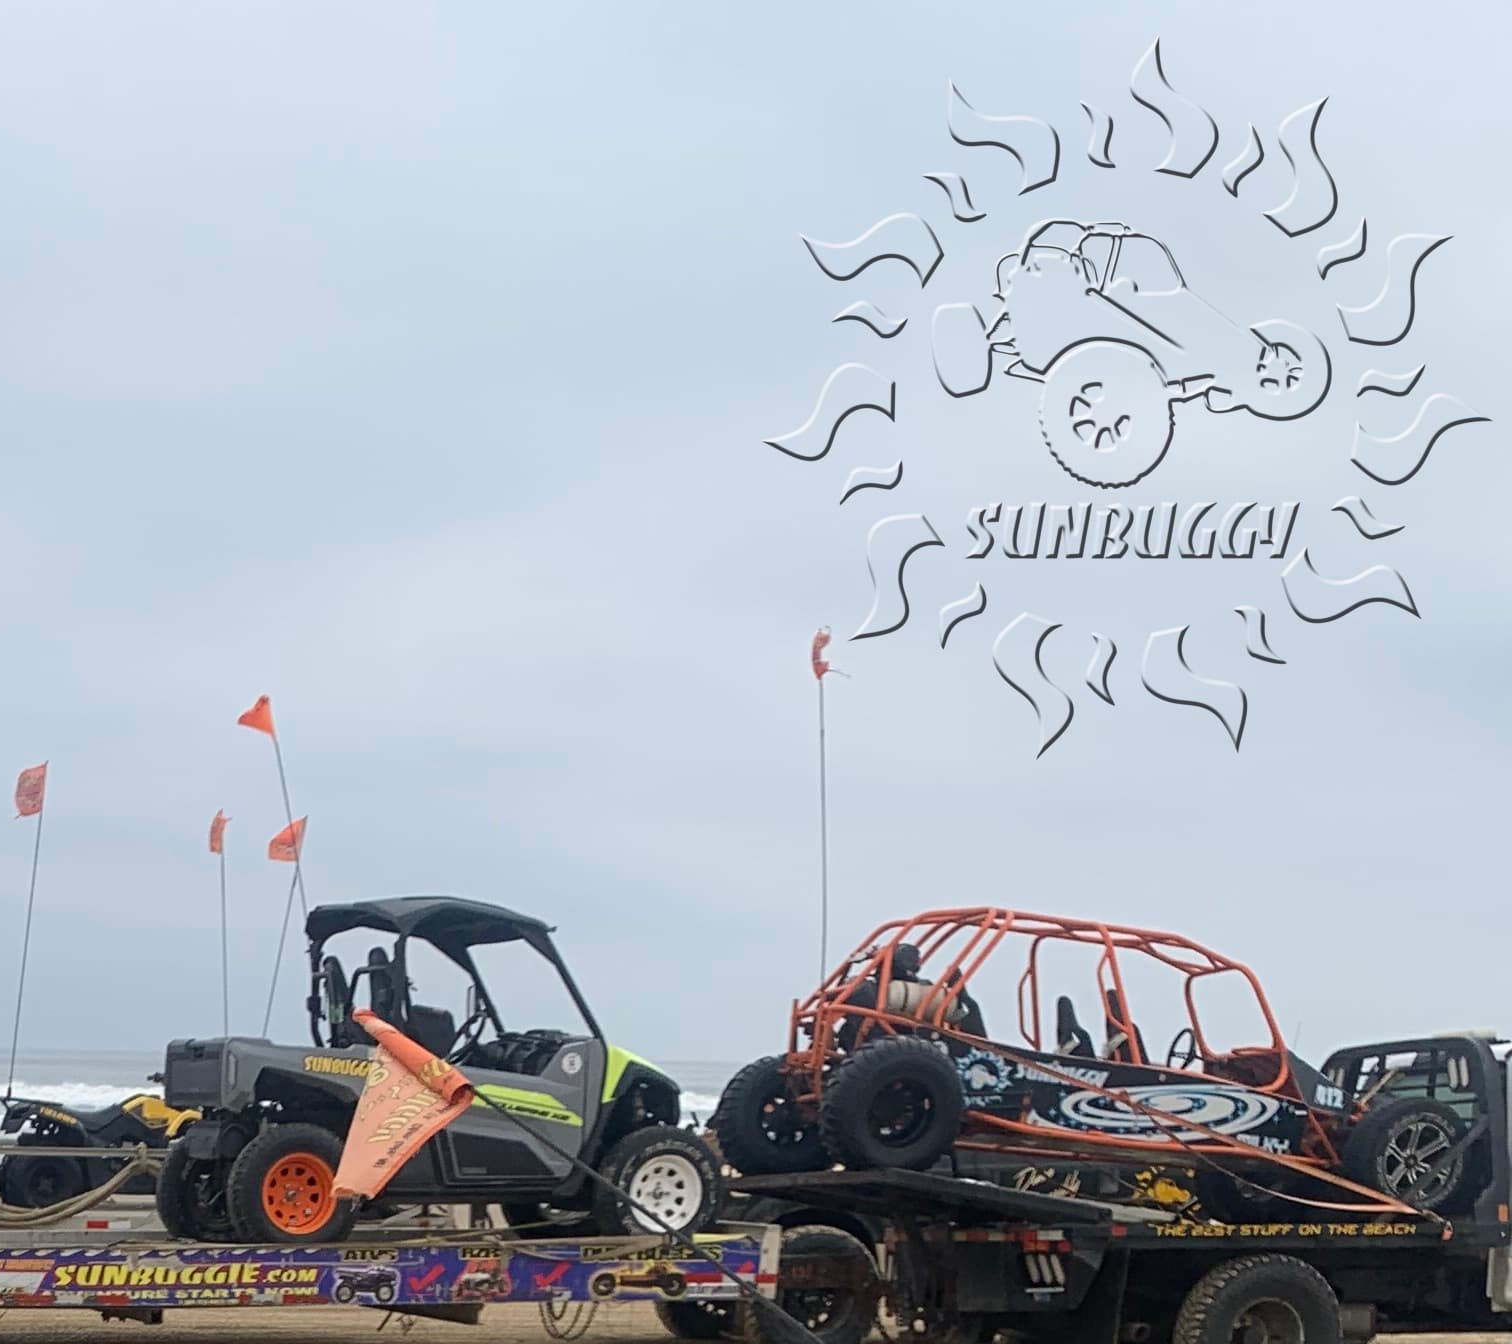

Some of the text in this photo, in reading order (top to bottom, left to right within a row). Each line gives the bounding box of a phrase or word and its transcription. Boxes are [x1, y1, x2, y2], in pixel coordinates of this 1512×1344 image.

[304, 1056, 369, 1077] SUNBUGG
[1191, 1224, 1236, 1237] BEST
[1240, 1224, 1294, 1236] STUFF
[1298, 1224, 1322, 1236] ON
[1328, 1224, 1358, 1236] THE
[1362, 1224, 1417, 1236] BEACH
